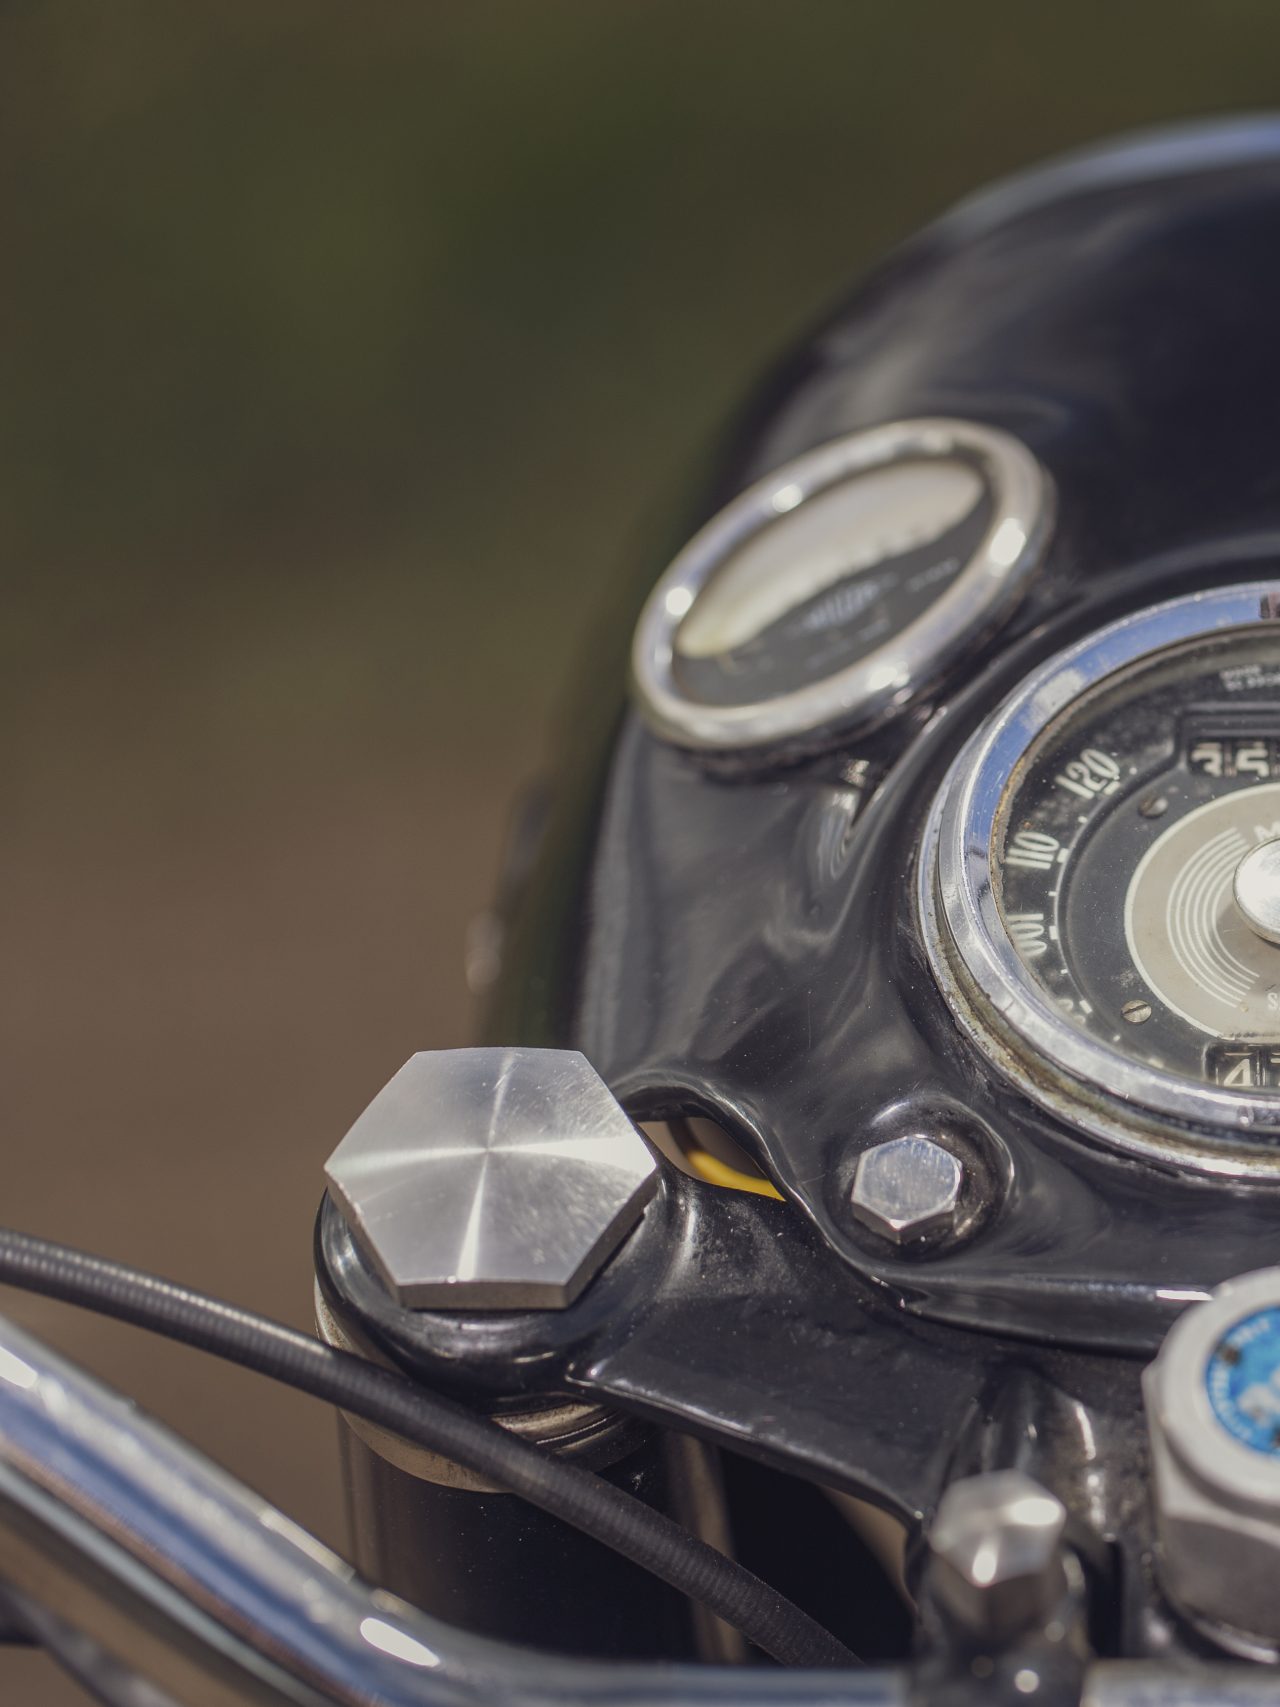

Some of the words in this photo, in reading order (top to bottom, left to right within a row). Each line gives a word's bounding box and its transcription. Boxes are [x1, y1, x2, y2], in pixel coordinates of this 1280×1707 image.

[1055, 749, 1120, 799] 120
[1005, 831, 1059, 869] 110
[1007, 913, 1047, 957] 100
